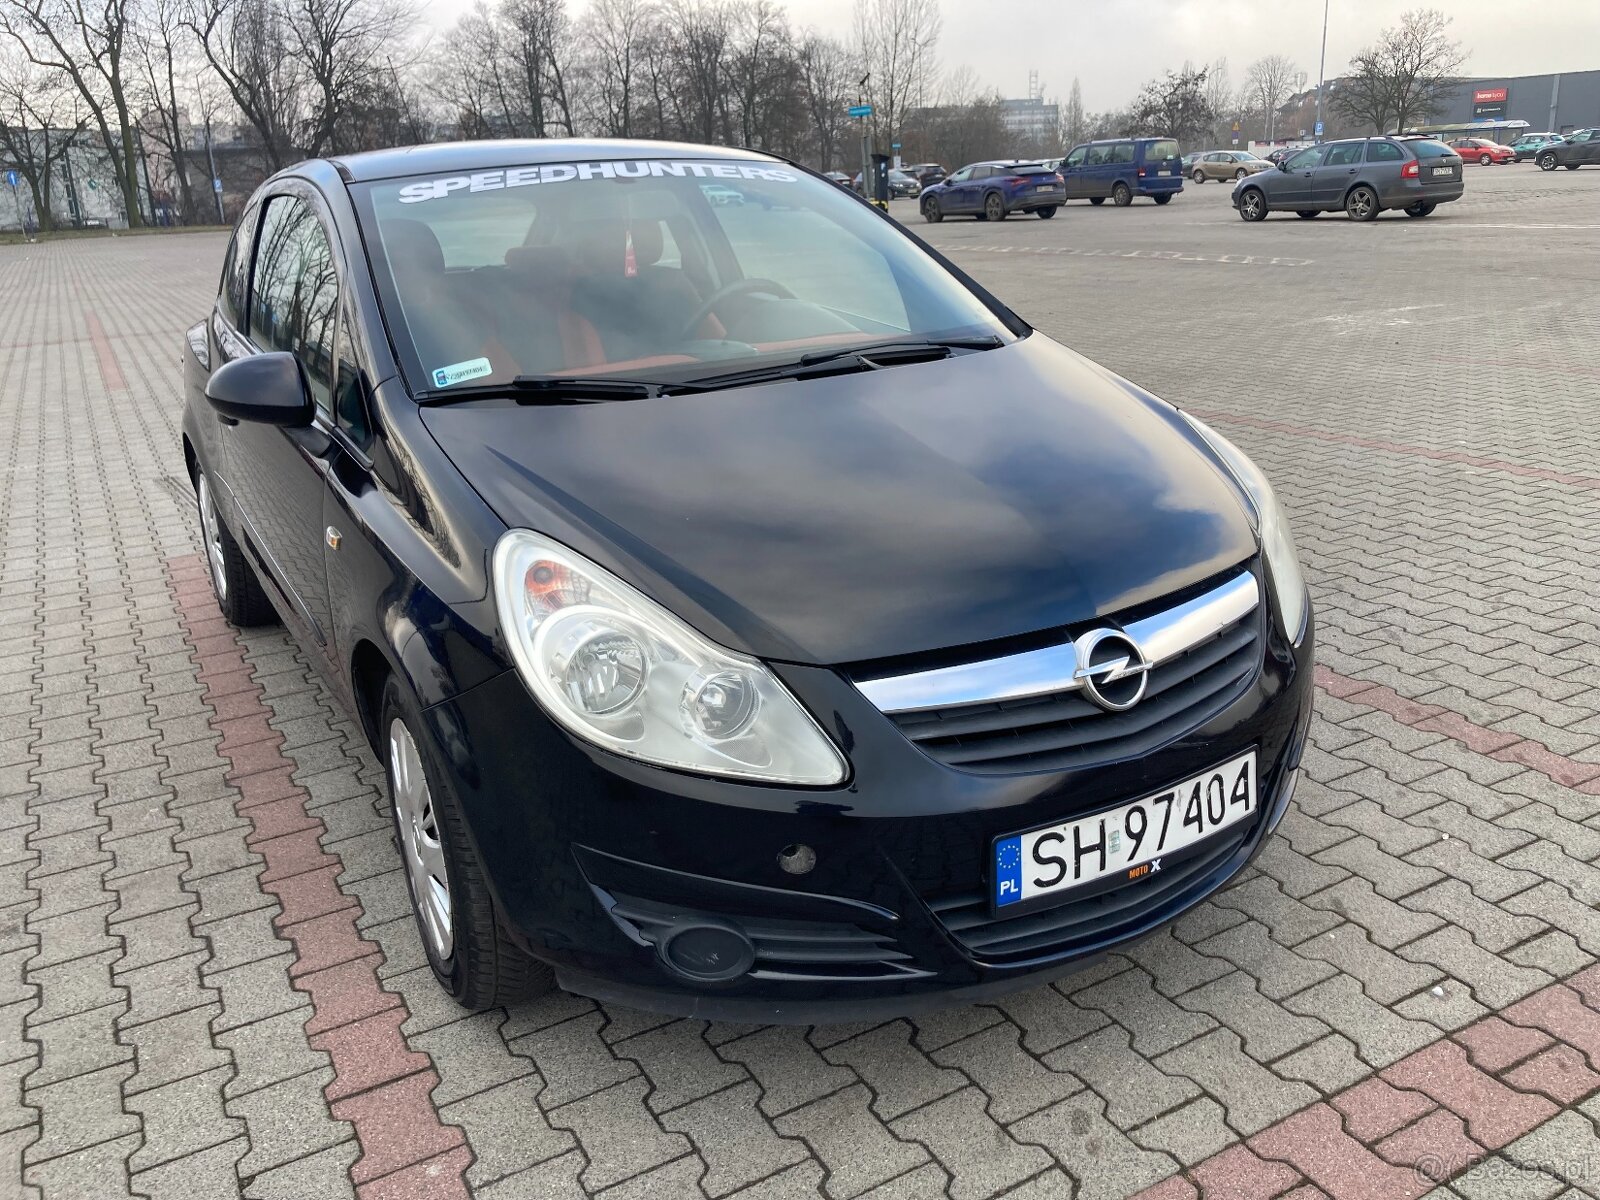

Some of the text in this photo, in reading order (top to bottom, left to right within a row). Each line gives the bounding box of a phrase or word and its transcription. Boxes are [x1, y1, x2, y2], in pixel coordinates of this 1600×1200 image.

[399, 160, 798, 203] SPEEDHUNTERS
[1032, 761, 1250, 888] SH 97404
[1129, 858, 1162, 879] MOTO X
[1000, 880, 1019, 896] PL
